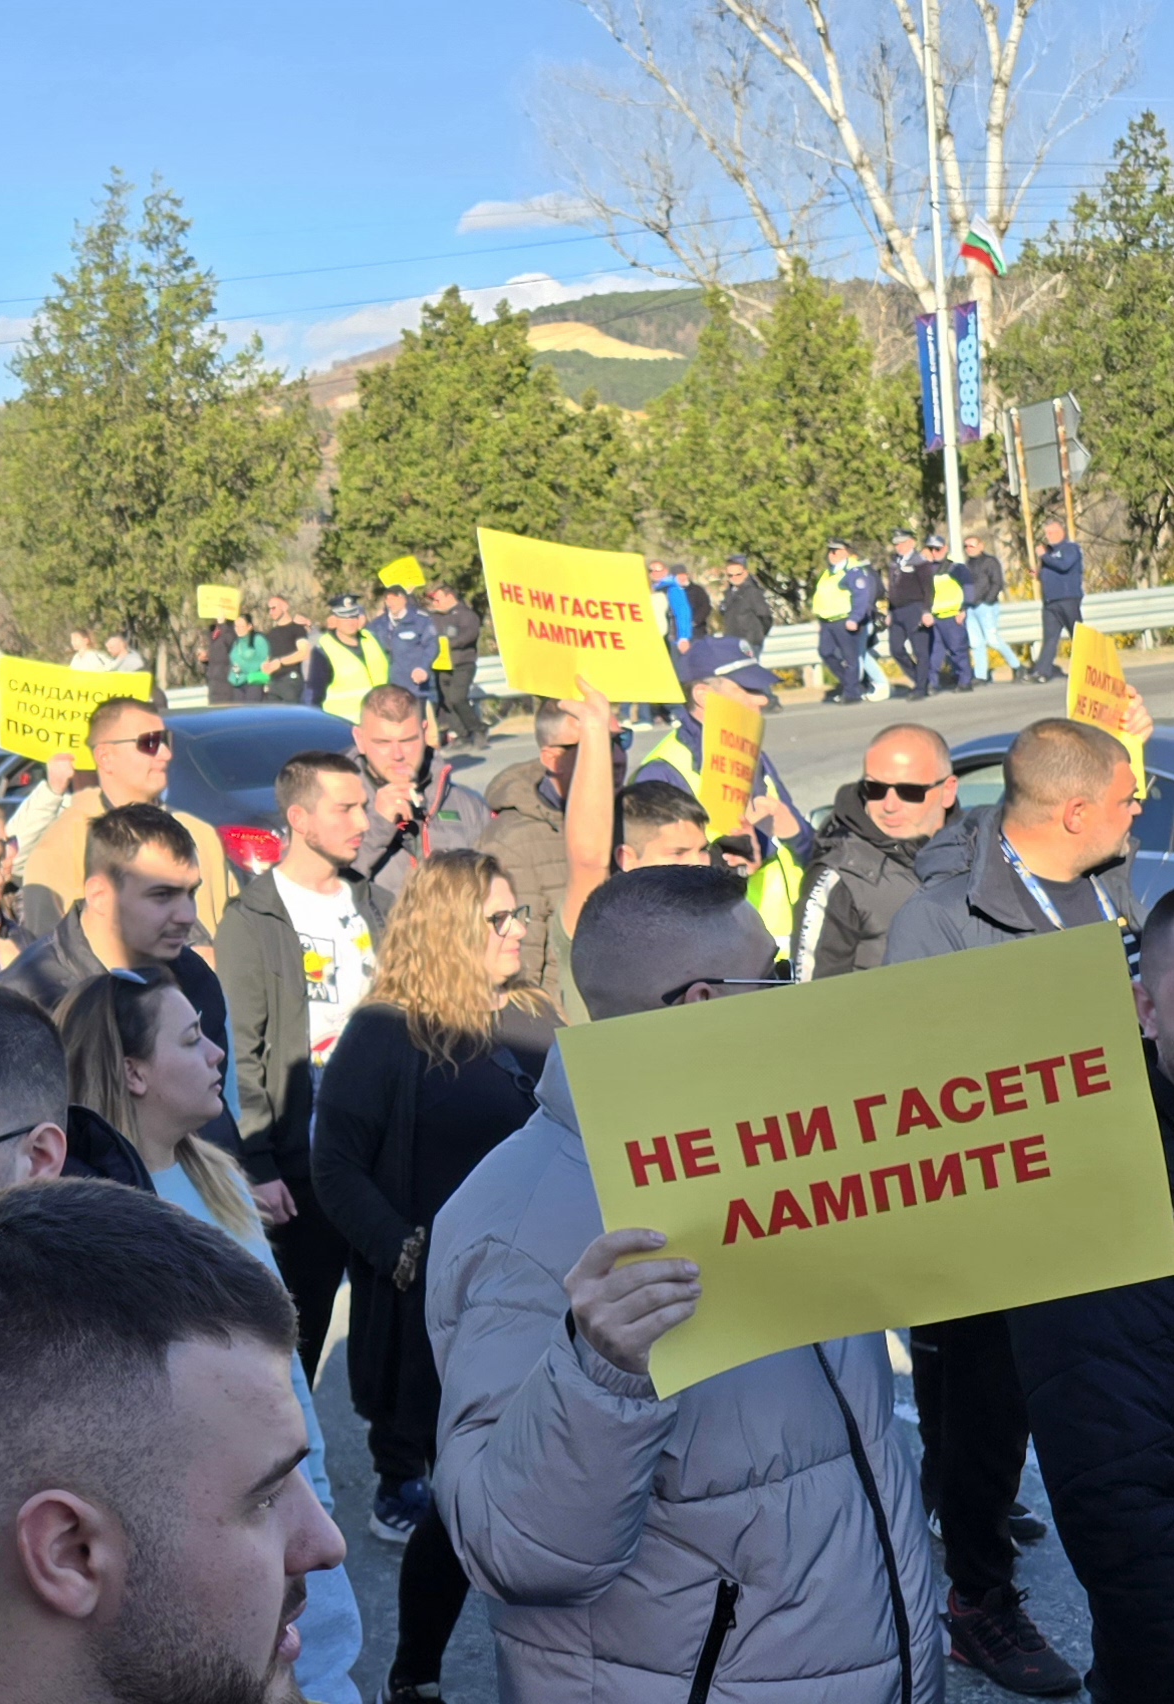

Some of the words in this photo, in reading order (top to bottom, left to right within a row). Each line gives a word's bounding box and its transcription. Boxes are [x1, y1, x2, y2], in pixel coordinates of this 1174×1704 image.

[500, 582, 524, 605] НЕ
[528, 588, 555, 612] НИ
[560, 595, 643, 623] ГАСЕТЕ
[527, 619, 626, 650] ЛАМПИТЕ
[17, 701, 92, 722] ПОДКРЕ
[6, 718, 81, 748] ПРОТЕ
[624, 1127, 720, 1188] НЕ
[735, 1105, 836, 1167] НИ
[853, 1046, 1112, 1144] ГАСЕТЕ
[721, 1133, 1051, 1245] ЛАМПИТЕ
